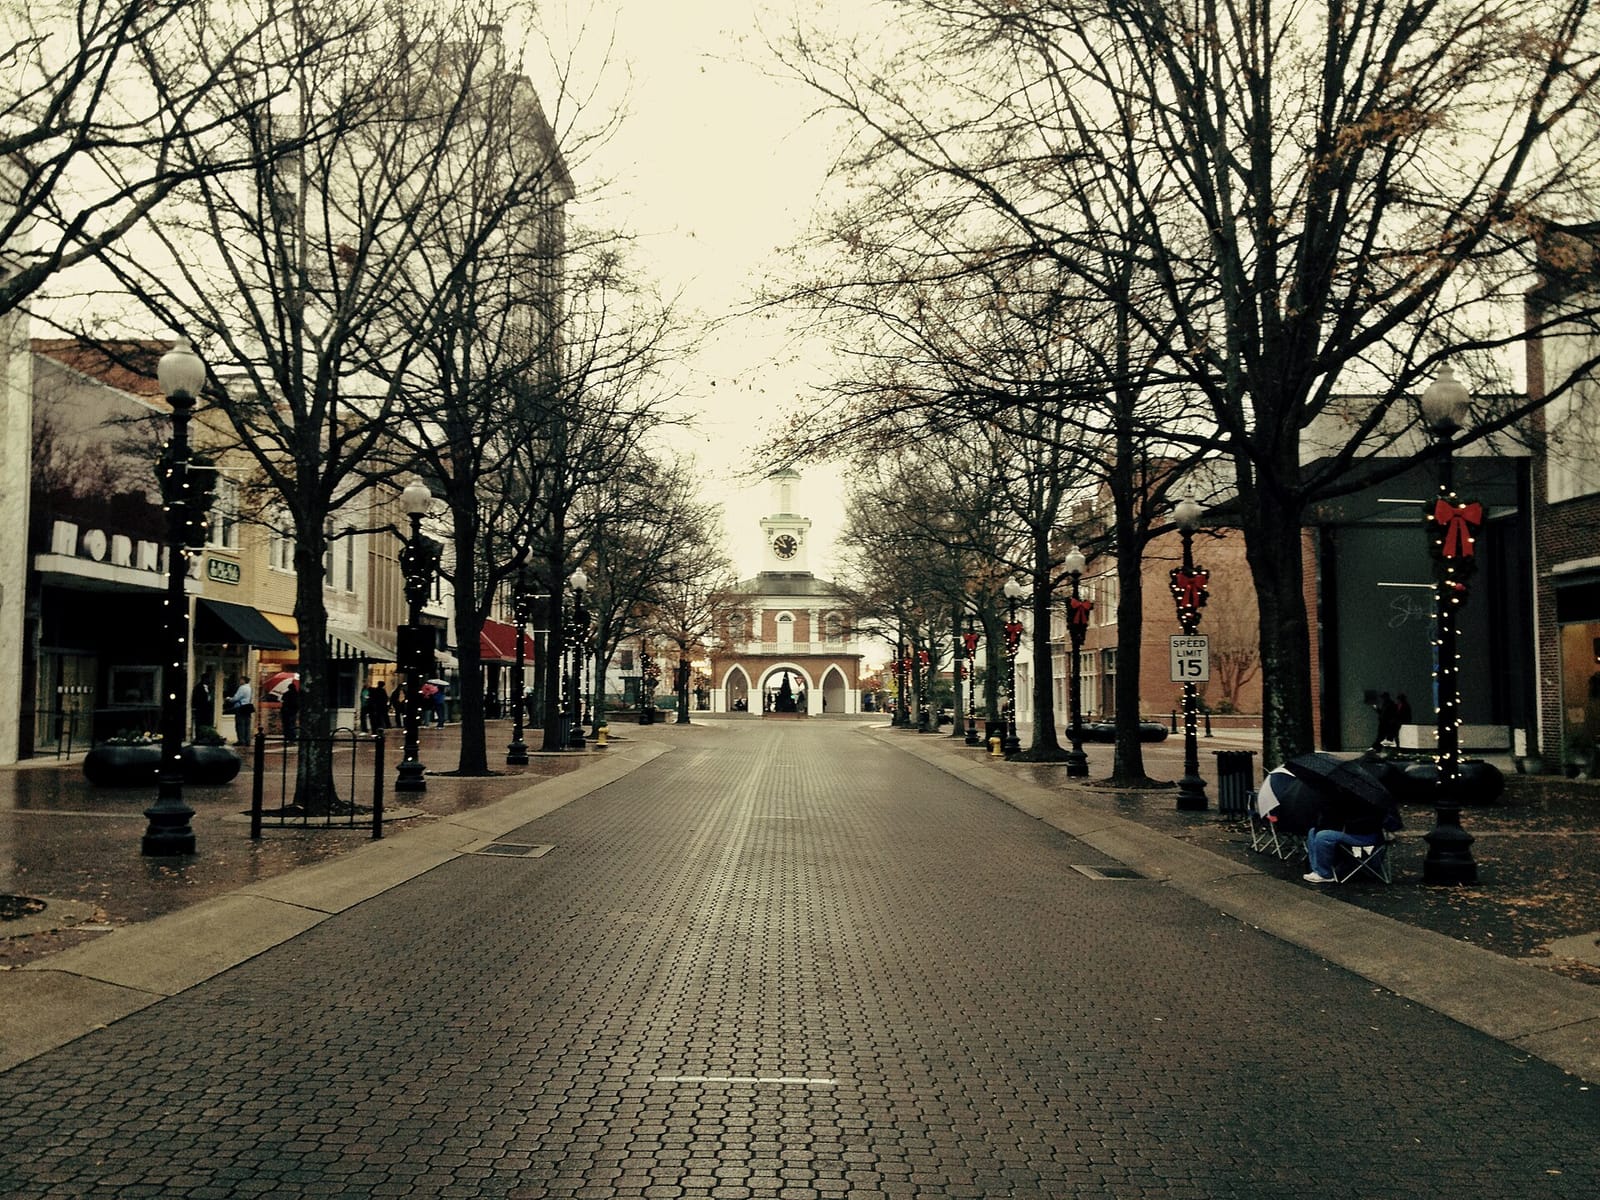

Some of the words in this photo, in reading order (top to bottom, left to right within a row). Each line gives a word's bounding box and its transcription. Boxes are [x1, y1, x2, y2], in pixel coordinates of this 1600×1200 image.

[1172, 640, 1206, 648] SPEED
[1176, 649, 1202, 657] LIMIT
[1177, 659, 1202, 677] 15
